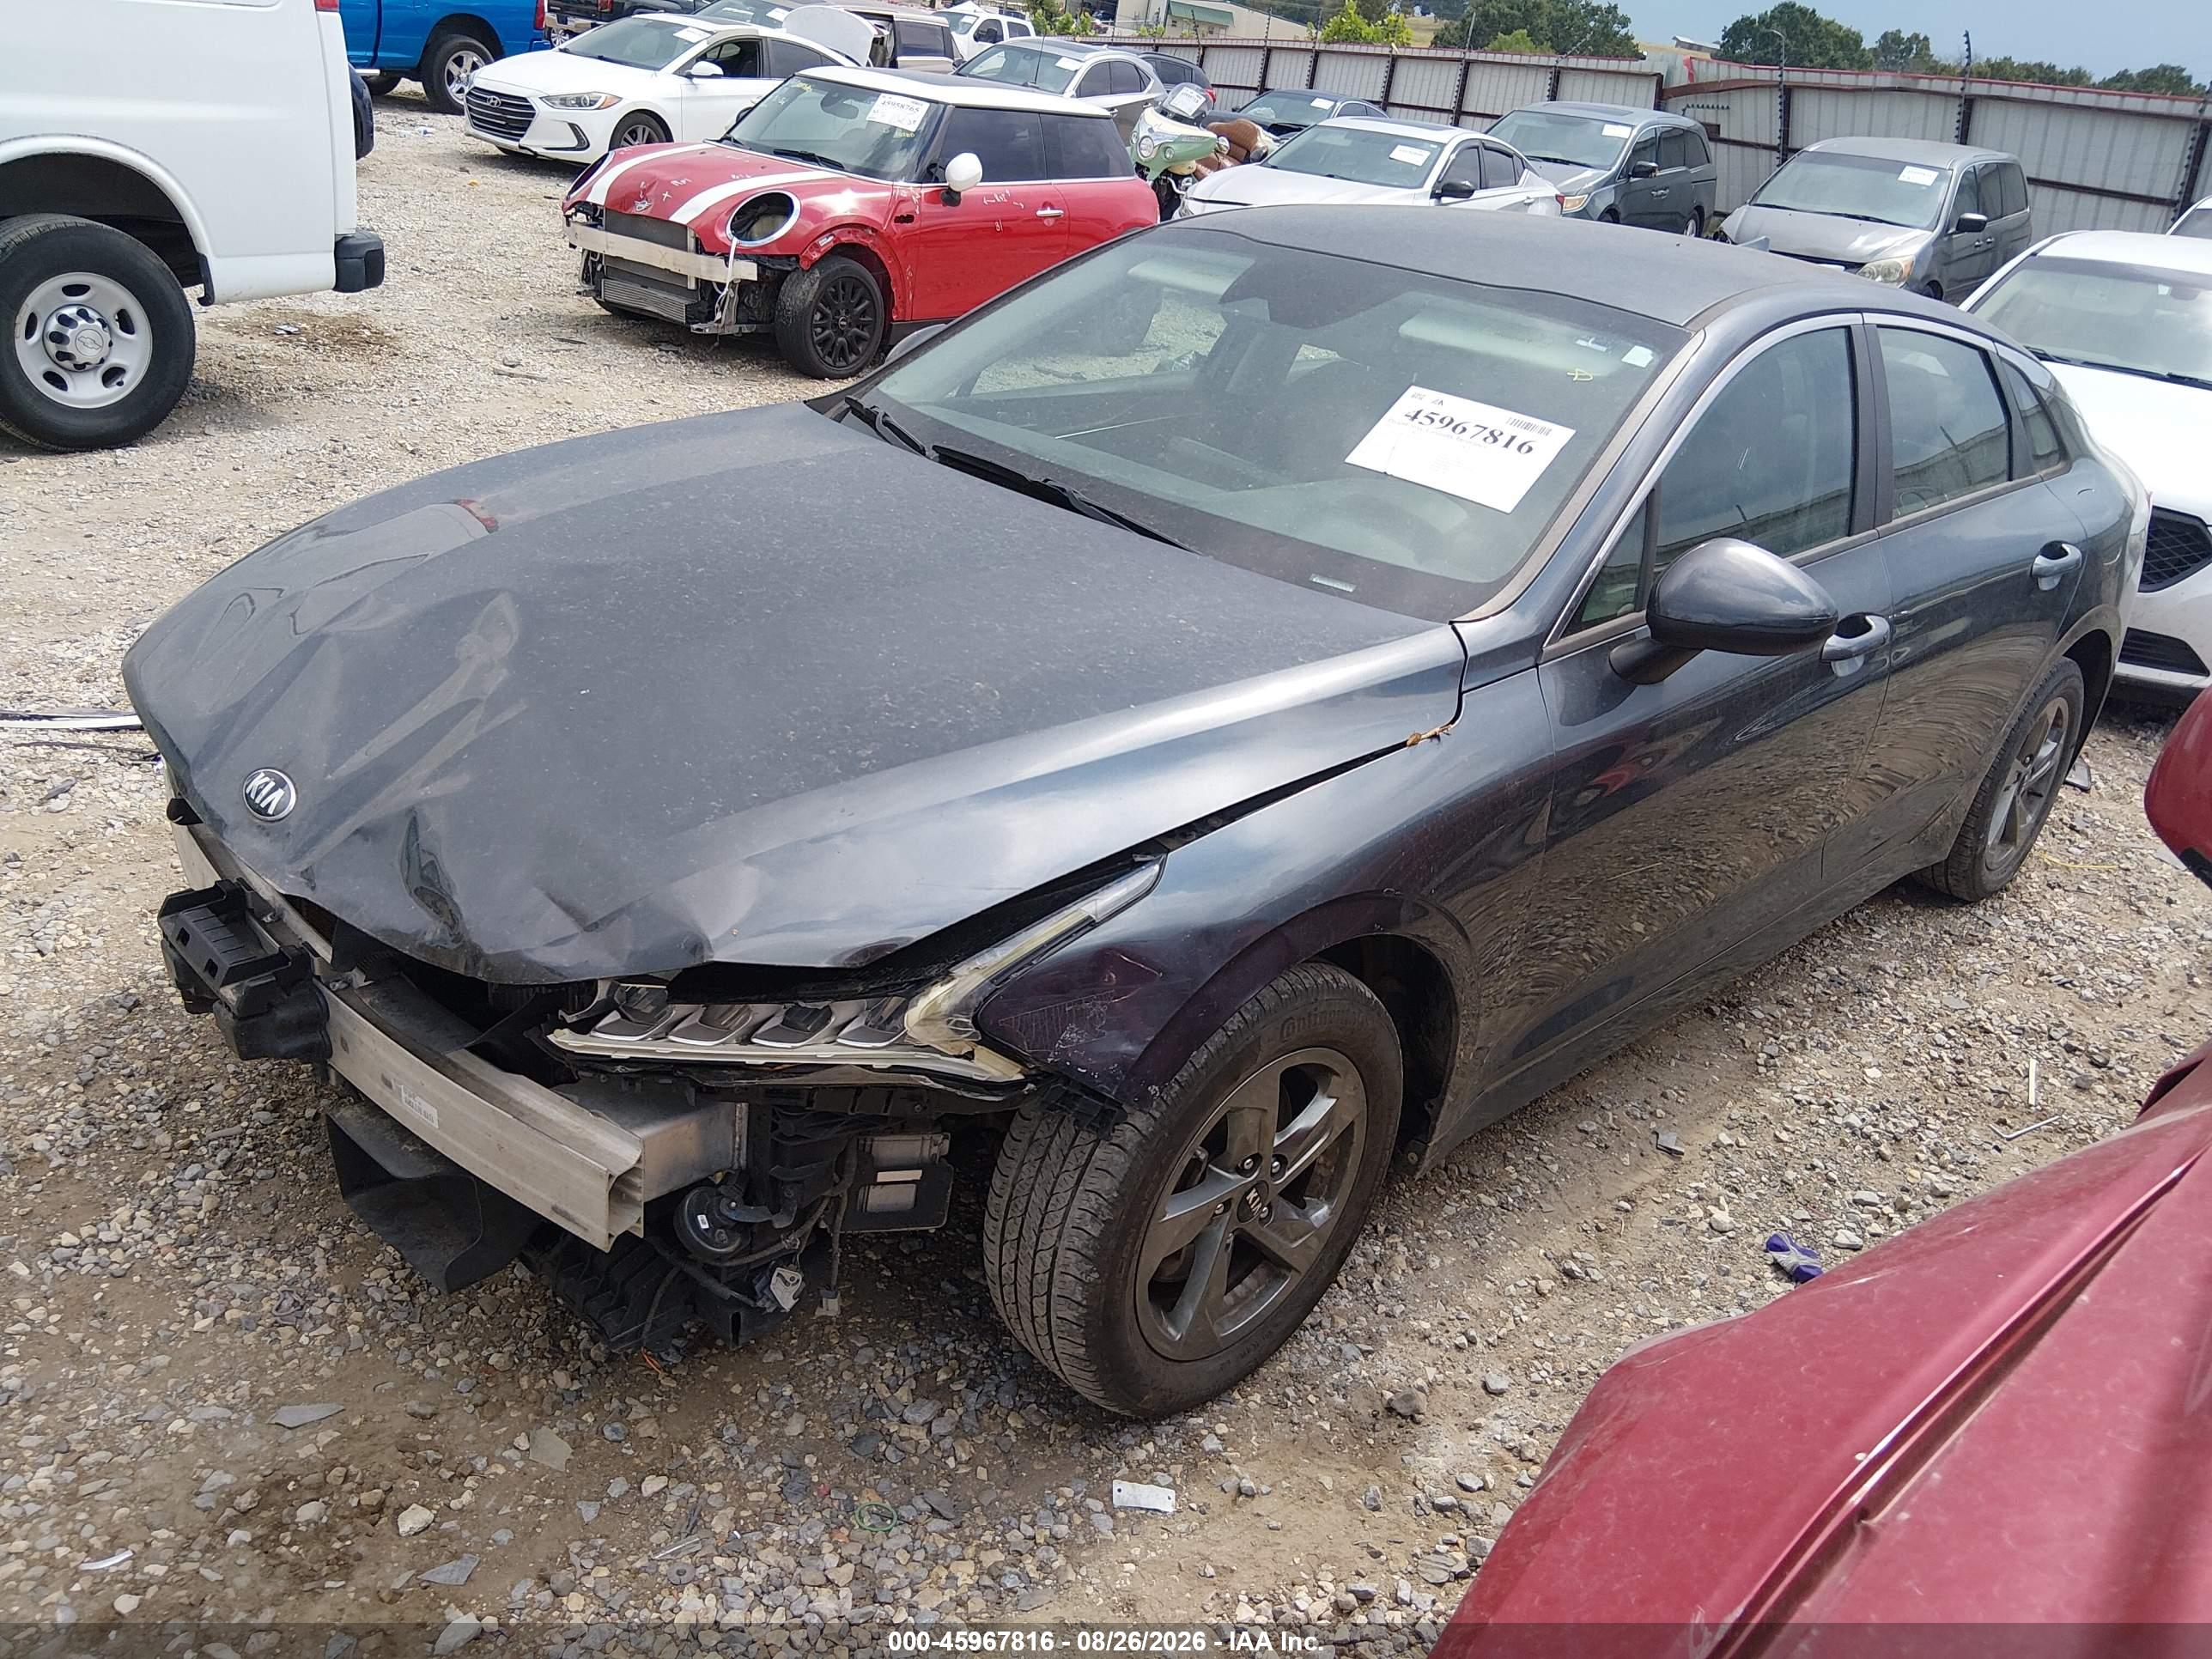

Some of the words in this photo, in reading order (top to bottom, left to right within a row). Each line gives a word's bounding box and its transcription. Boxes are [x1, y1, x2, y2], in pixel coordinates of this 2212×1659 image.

[1404, 407, 1535, 456] 45967816
[245, 772, 285, 816] KIA
[1245, 1187, 1263, 1217] KIA
